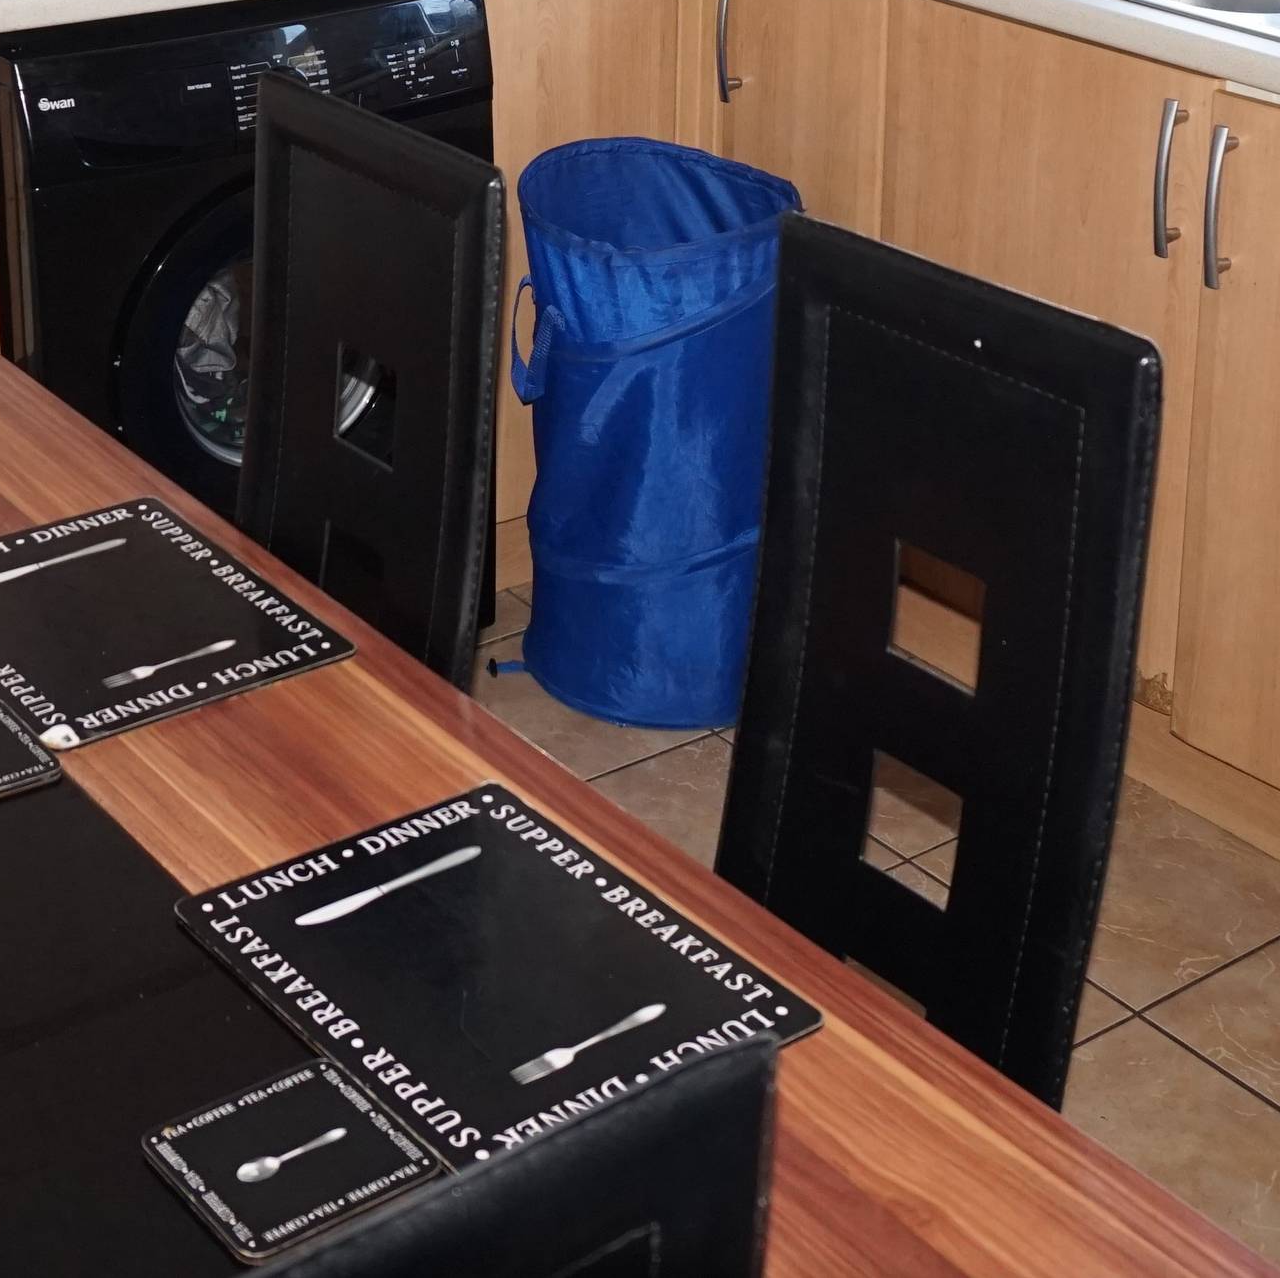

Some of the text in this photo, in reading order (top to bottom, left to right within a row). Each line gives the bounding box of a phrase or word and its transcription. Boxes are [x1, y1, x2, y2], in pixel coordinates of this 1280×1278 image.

[38, 96, 76, 112] Swan
[29, 507, 134, 544] DINNER
[141, 509, 323, 641] SUPPER BREAKFAST
[80, 642, 317, 730] LUNCH DINNER
[217, 798, 481, 910] LUNCH DINNER
[489, 802, 775, 1004] SUPPER BREAKFAST
[210, 915, 482, 1152] SUPPER BREAKFAST
[192, 1102, 237, 1128] COFFEE
[244, 1088, 269, 1106] TEA
[271, 1068, 315, 1093] COFFEE
